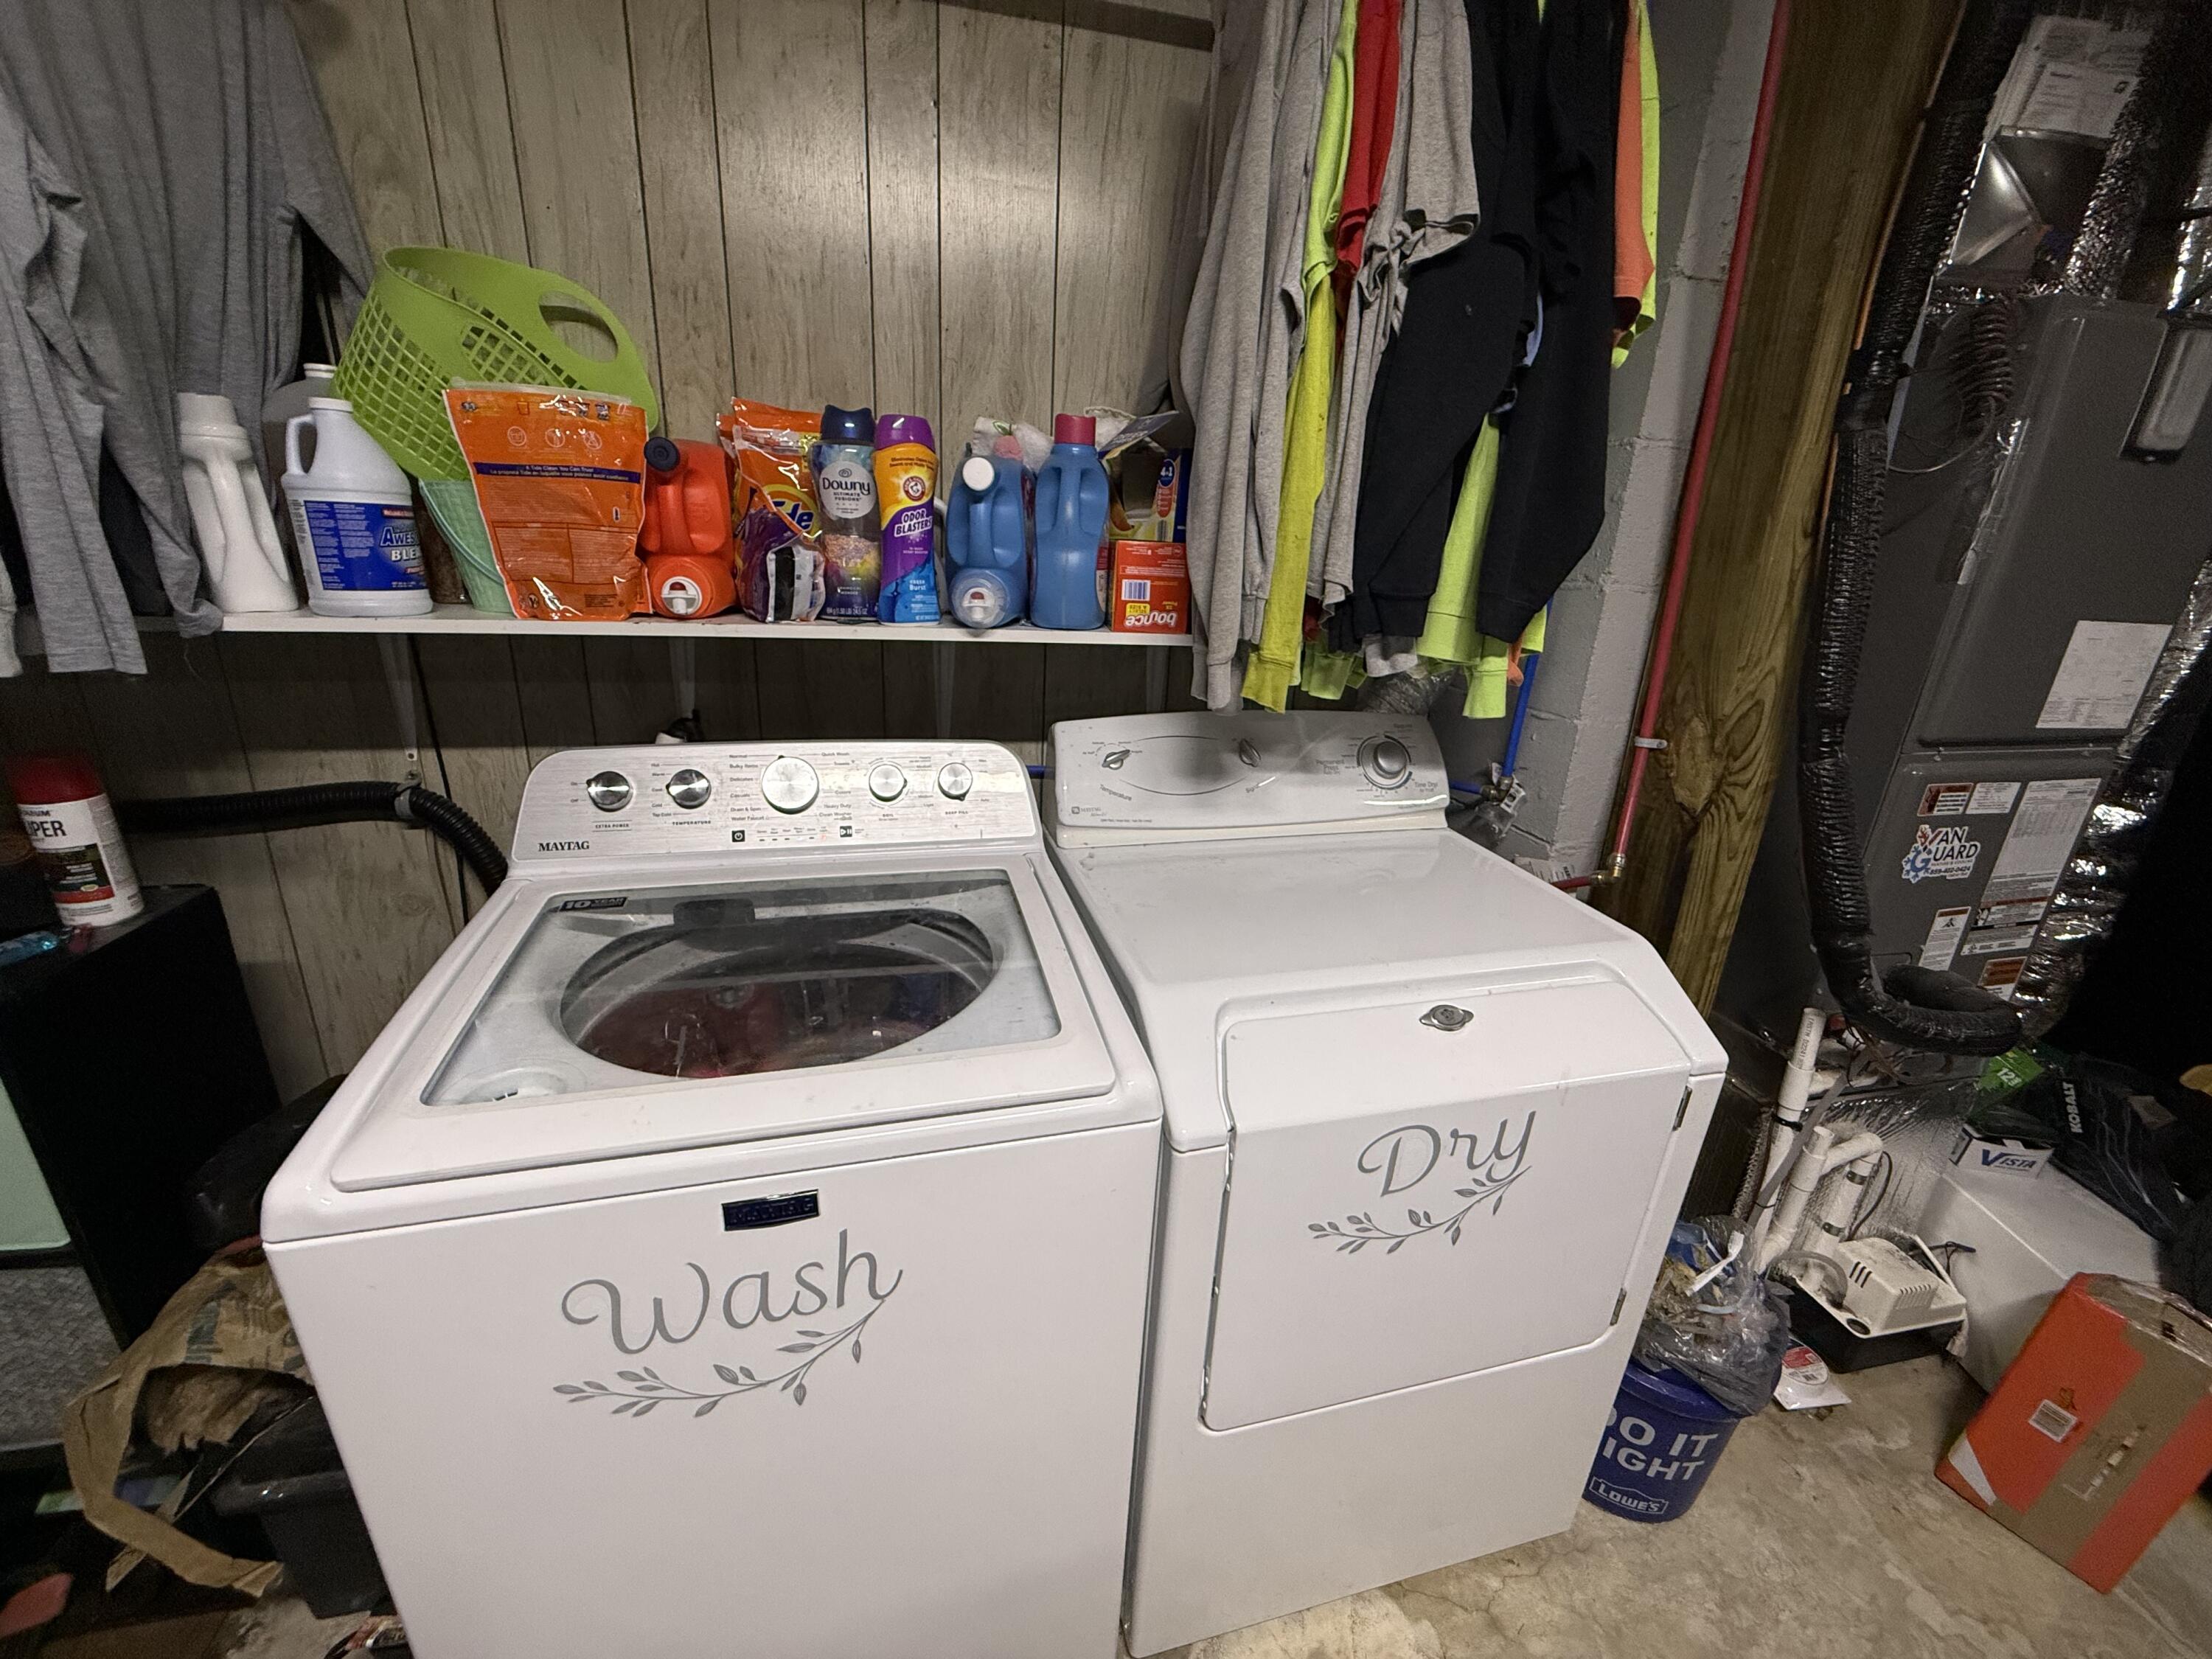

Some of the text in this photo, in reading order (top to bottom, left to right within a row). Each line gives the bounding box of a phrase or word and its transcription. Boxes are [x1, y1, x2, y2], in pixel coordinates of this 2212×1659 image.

[822, 478, 870, 495] Downy
[895, 518, 933, 535] BLASTERS
[903, 510, 926, 524] ODOR
[380, 526, 418, 546] AWES
[392, 549, 417, 561] BLE
[1124, 611, 1177, 627] bounce
[538, 841, 590, 852] MAYTAG
[564, 900, 591, 910] 10
[2062, 1082, 2084, 1133] KOBALT
[1357, 1110, 1537, 1197] Dry
[1981, 1149, 2037, 1169] VISTA
[561, 1228, 903, 1354] Wash
[1669, 1433, 1719, 1457] IT
[1602, 1436, 1705, 1481] IGHT
[1599, 1484, 1660, 1512] LOWE'S
